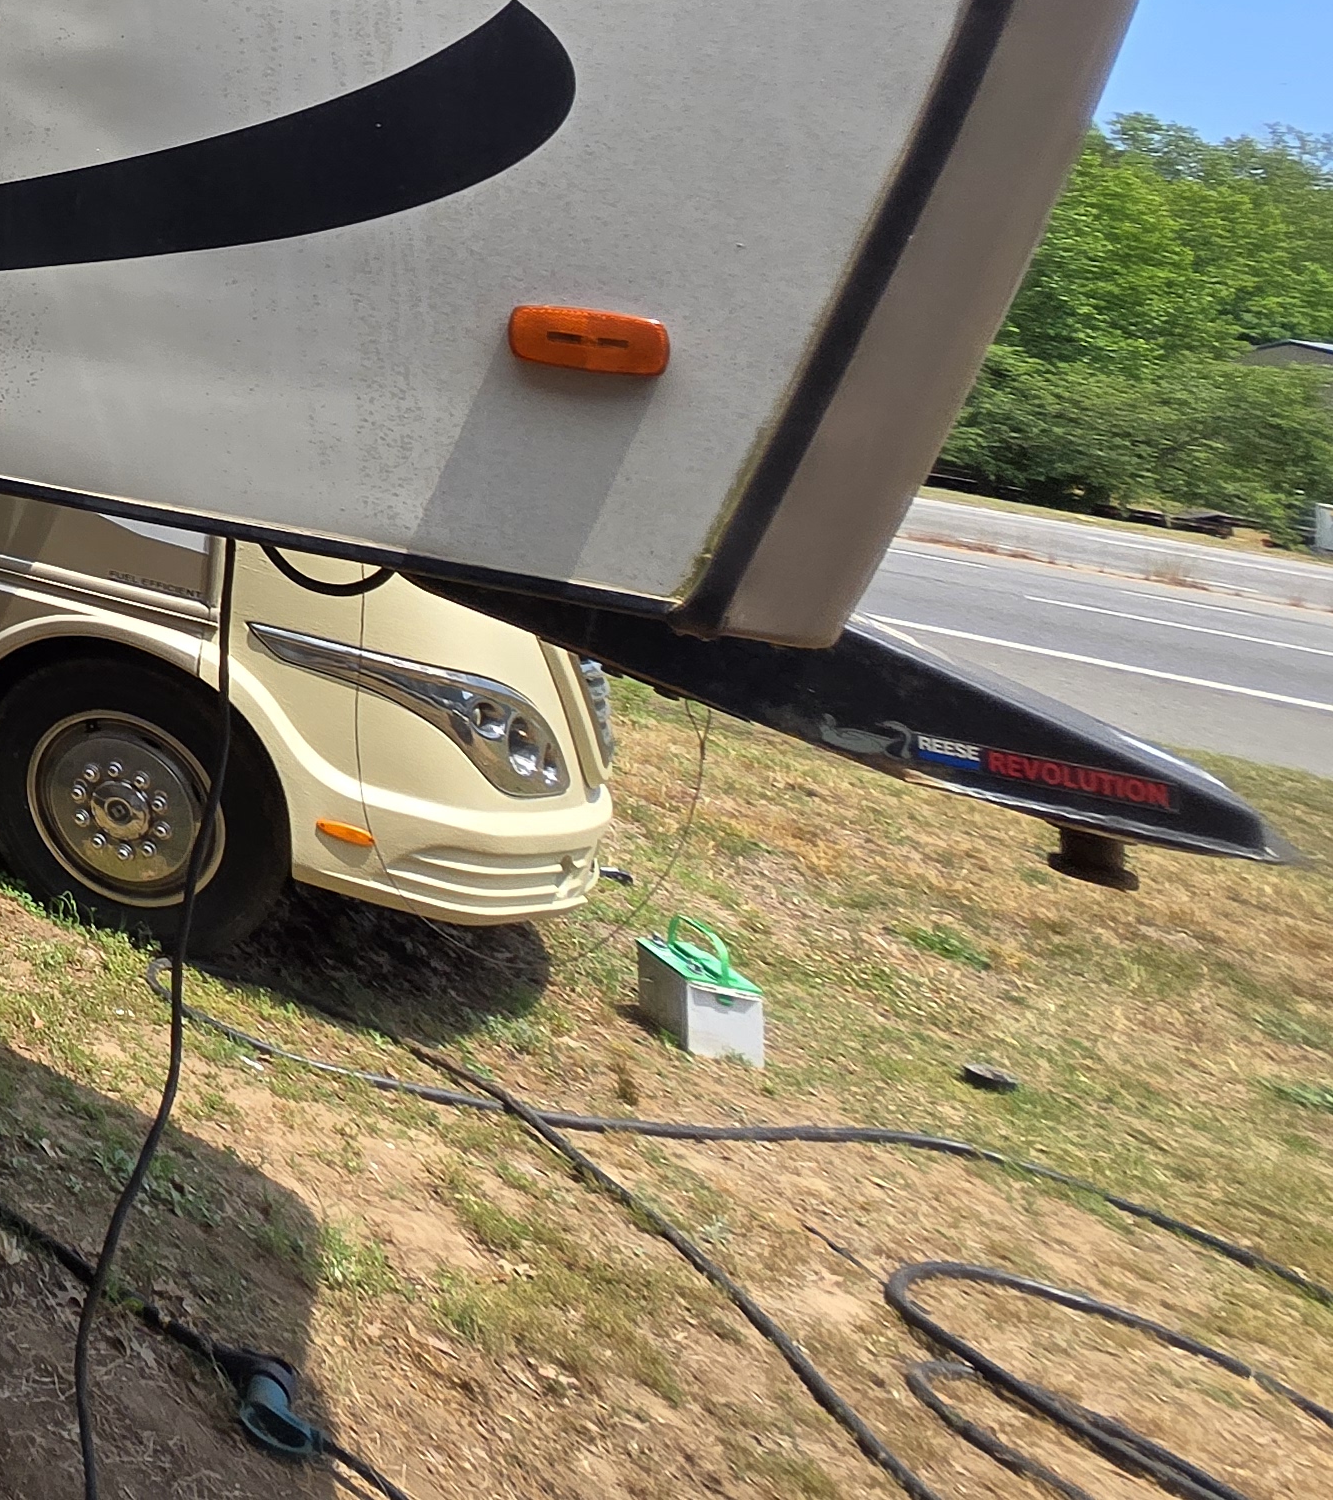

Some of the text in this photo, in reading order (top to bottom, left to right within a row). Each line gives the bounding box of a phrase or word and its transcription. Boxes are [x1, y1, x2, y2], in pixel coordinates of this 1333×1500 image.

[108, 570, 203, 599] FUEL EFFICIENT
[917, 735, 1171, 810] REESE REVOLUTION
